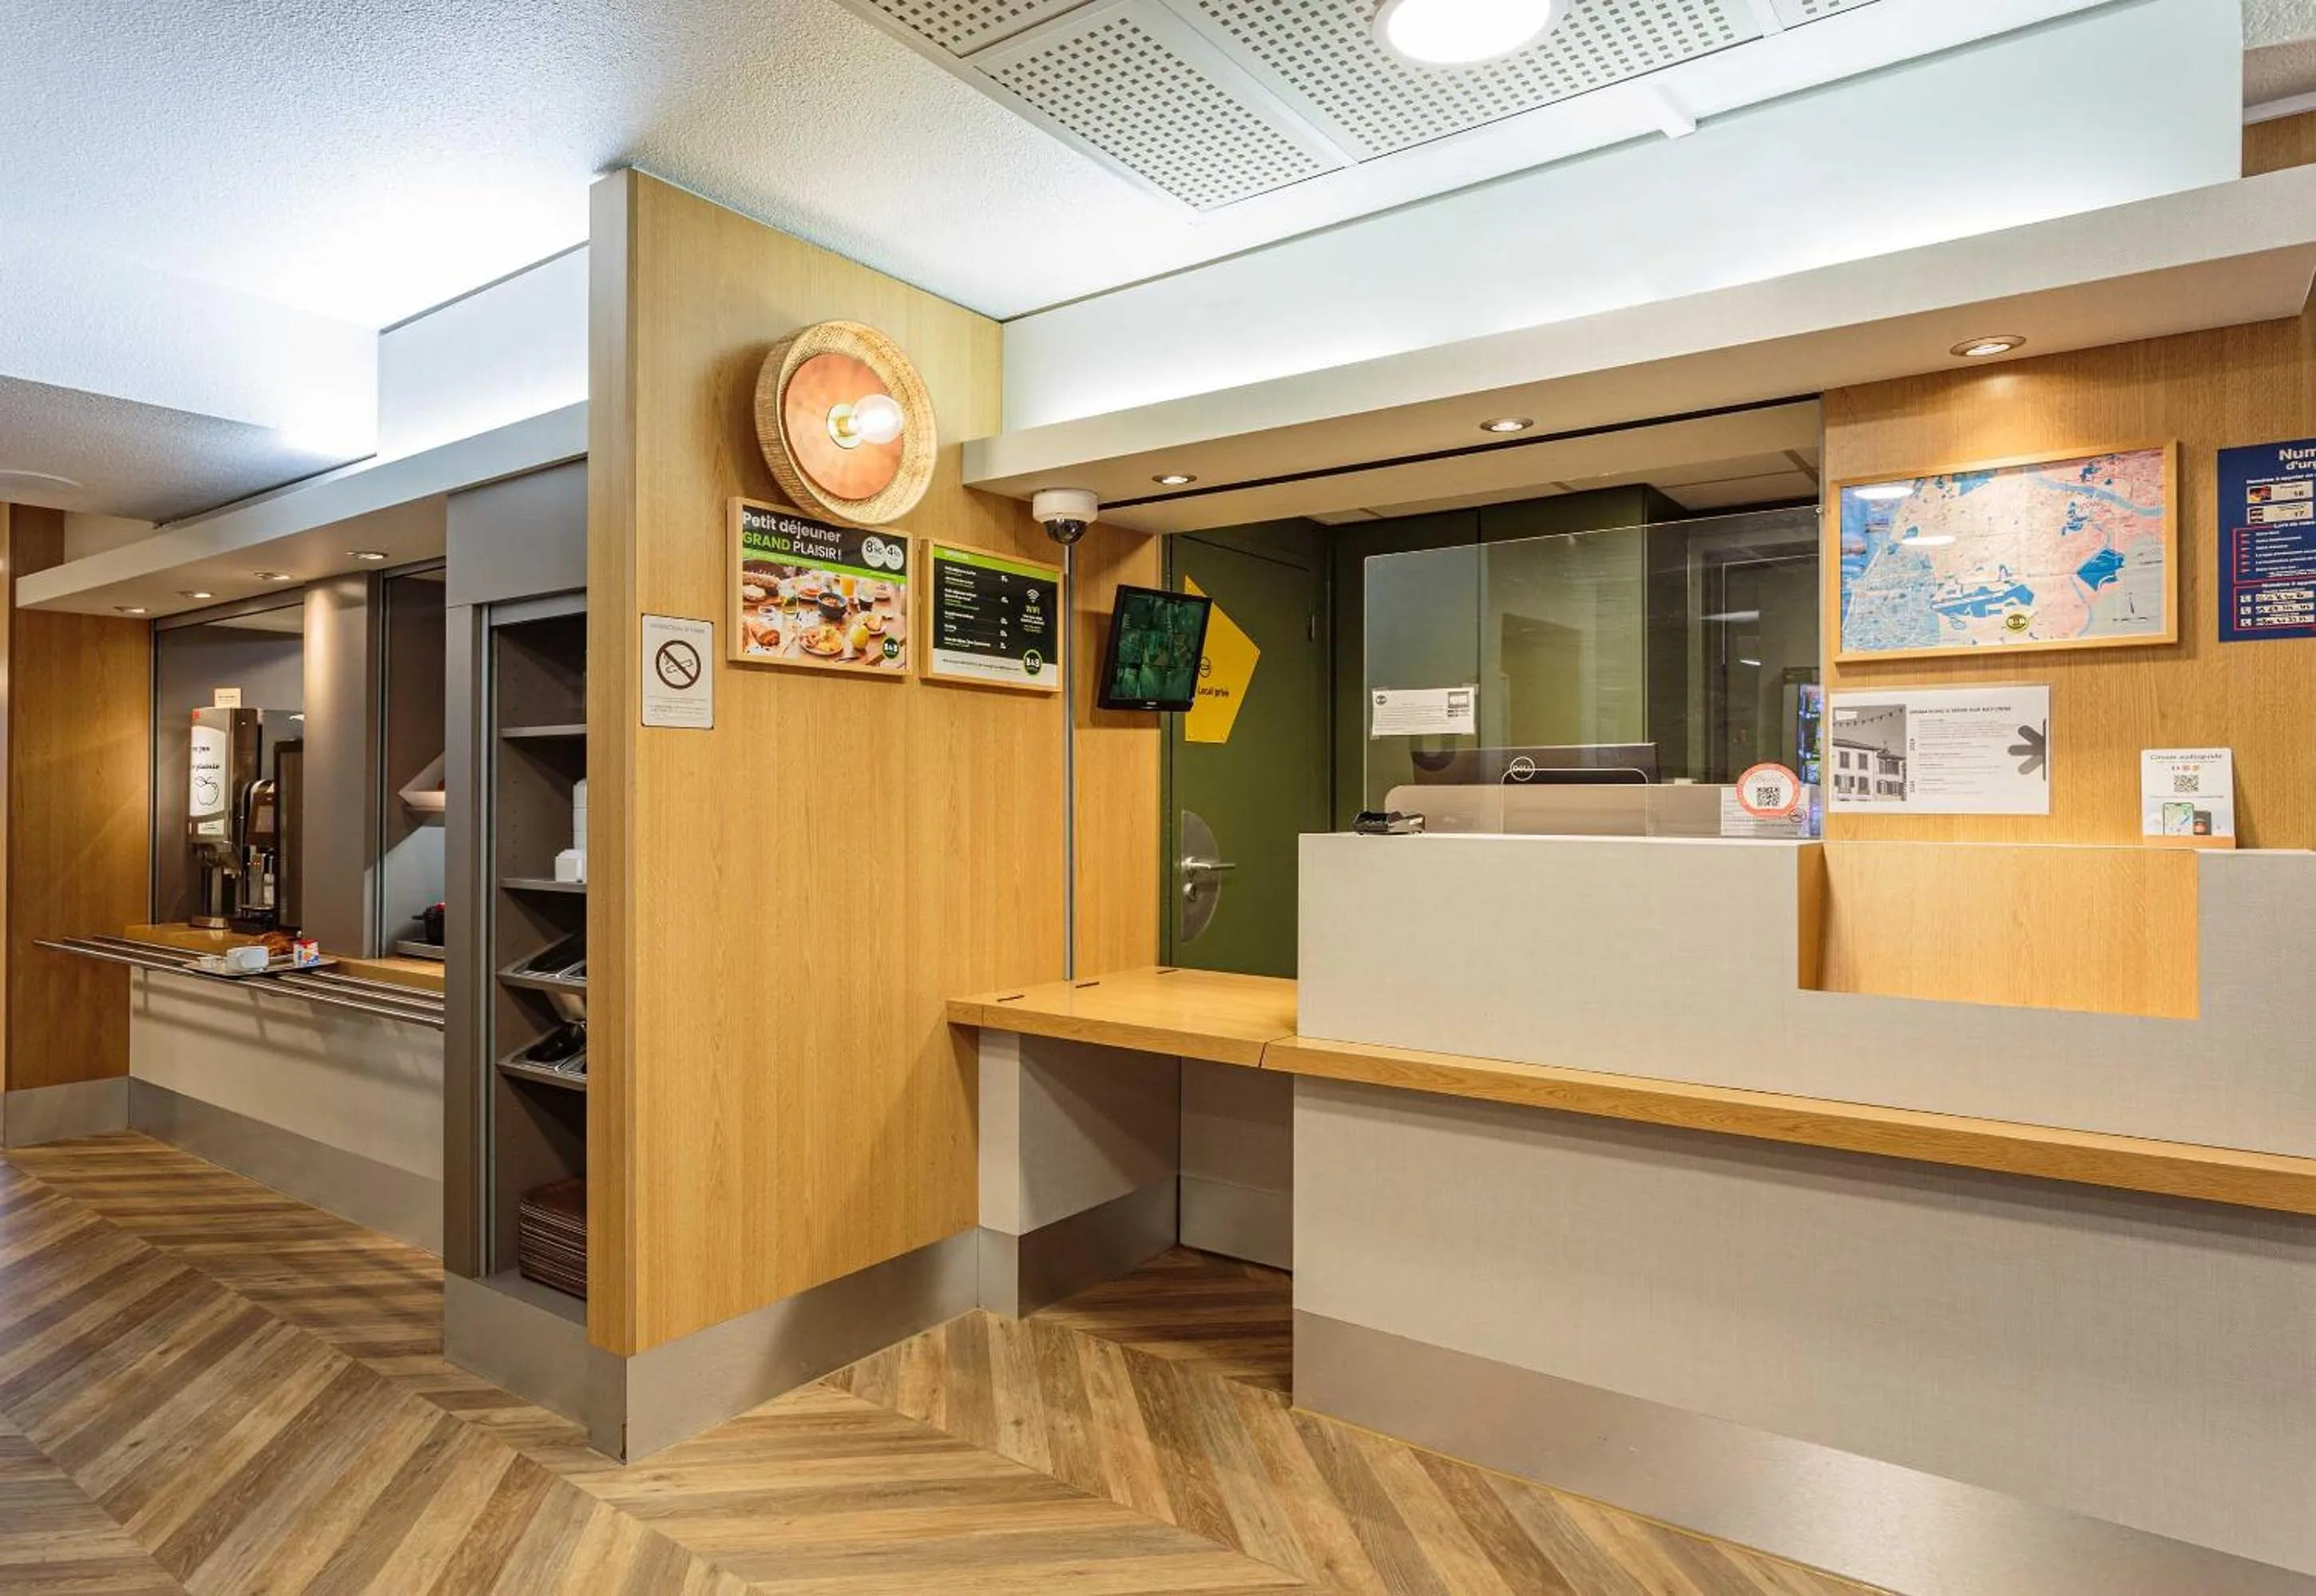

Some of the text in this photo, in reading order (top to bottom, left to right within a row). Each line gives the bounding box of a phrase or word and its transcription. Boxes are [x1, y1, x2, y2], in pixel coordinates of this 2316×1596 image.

[744, 511, 841, 543] Petit déjeuner
[743, 531, 791, 551] GRAND
[793, 541, 836, 560] PLAISIR
